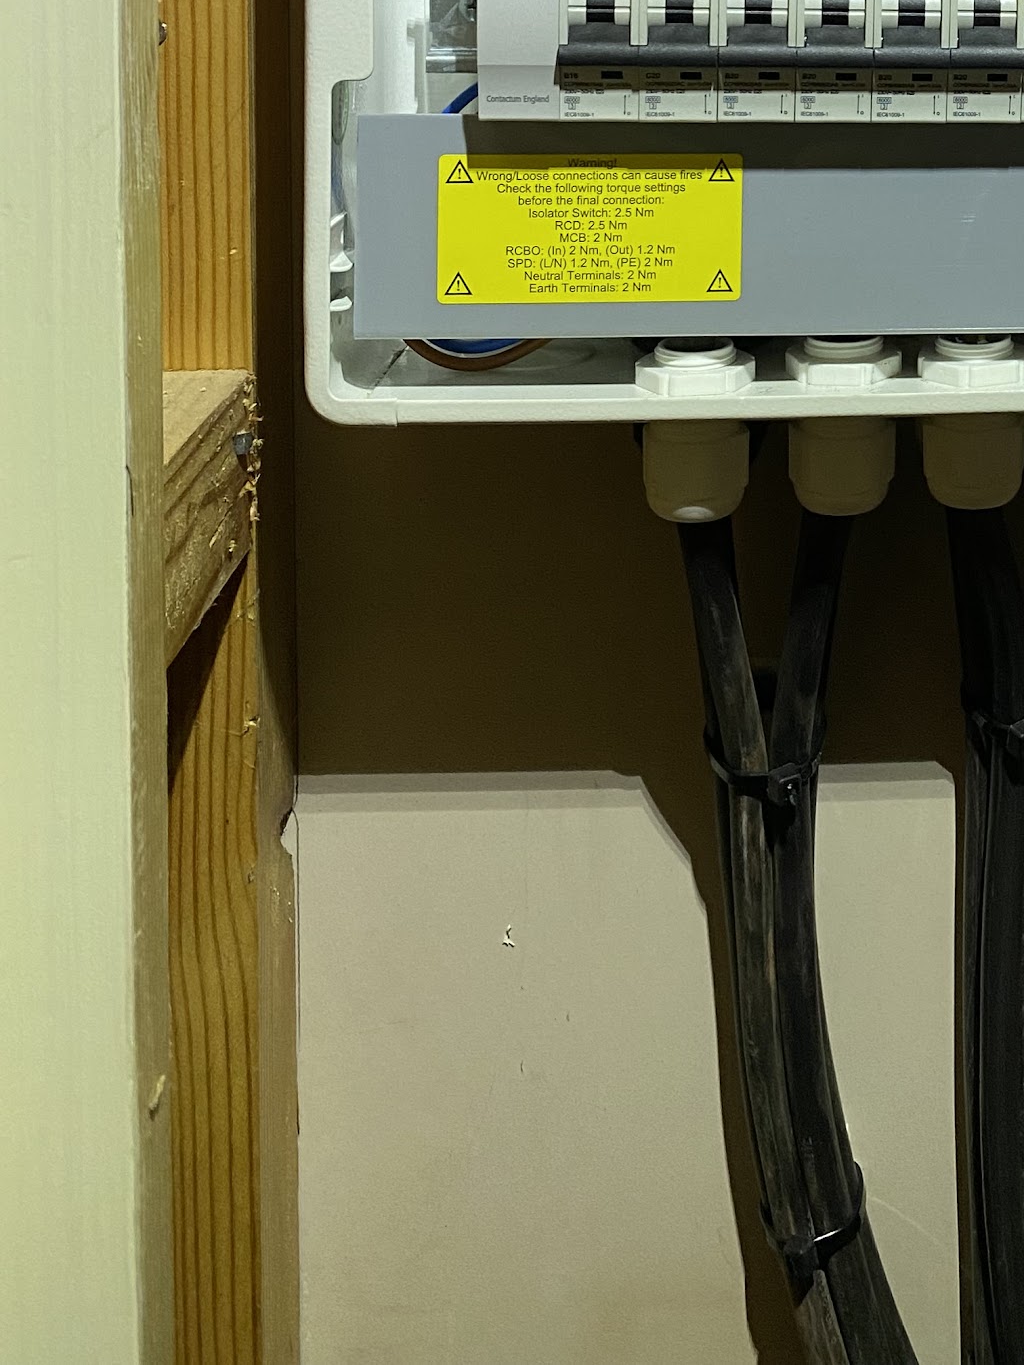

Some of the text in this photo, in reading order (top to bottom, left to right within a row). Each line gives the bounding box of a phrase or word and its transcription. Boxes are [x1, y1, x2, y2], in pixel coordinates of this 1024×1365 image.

[486, 95, 549, 104] Contactum England
[476, 170, 702, 183] Wrong/Loose connections can cause fires
[497, 182, 685, 194] Check the following torque settings
[519, 195, 664, 205] before the final connection:
[529, 208, 654, 218] Isolator Switch: 2.5 Nm
[556, 221, 627, 230] RCD: 2.5 Nm
[560, 233, 622, 242] MCB: 2 Nm
[506, 245, 675, 257] RCBO: (In) 2 Nm, (Out) 1.2 Nm
[508, 257, 672, 270] SPD: (L/N) 1.2 Nm, (PE) 2 Nm
[525, 269, 656, 280] Neutral Terminals: 2 Nm
[530, 283, 651, 293] Earth Terminals: 2 Nm
